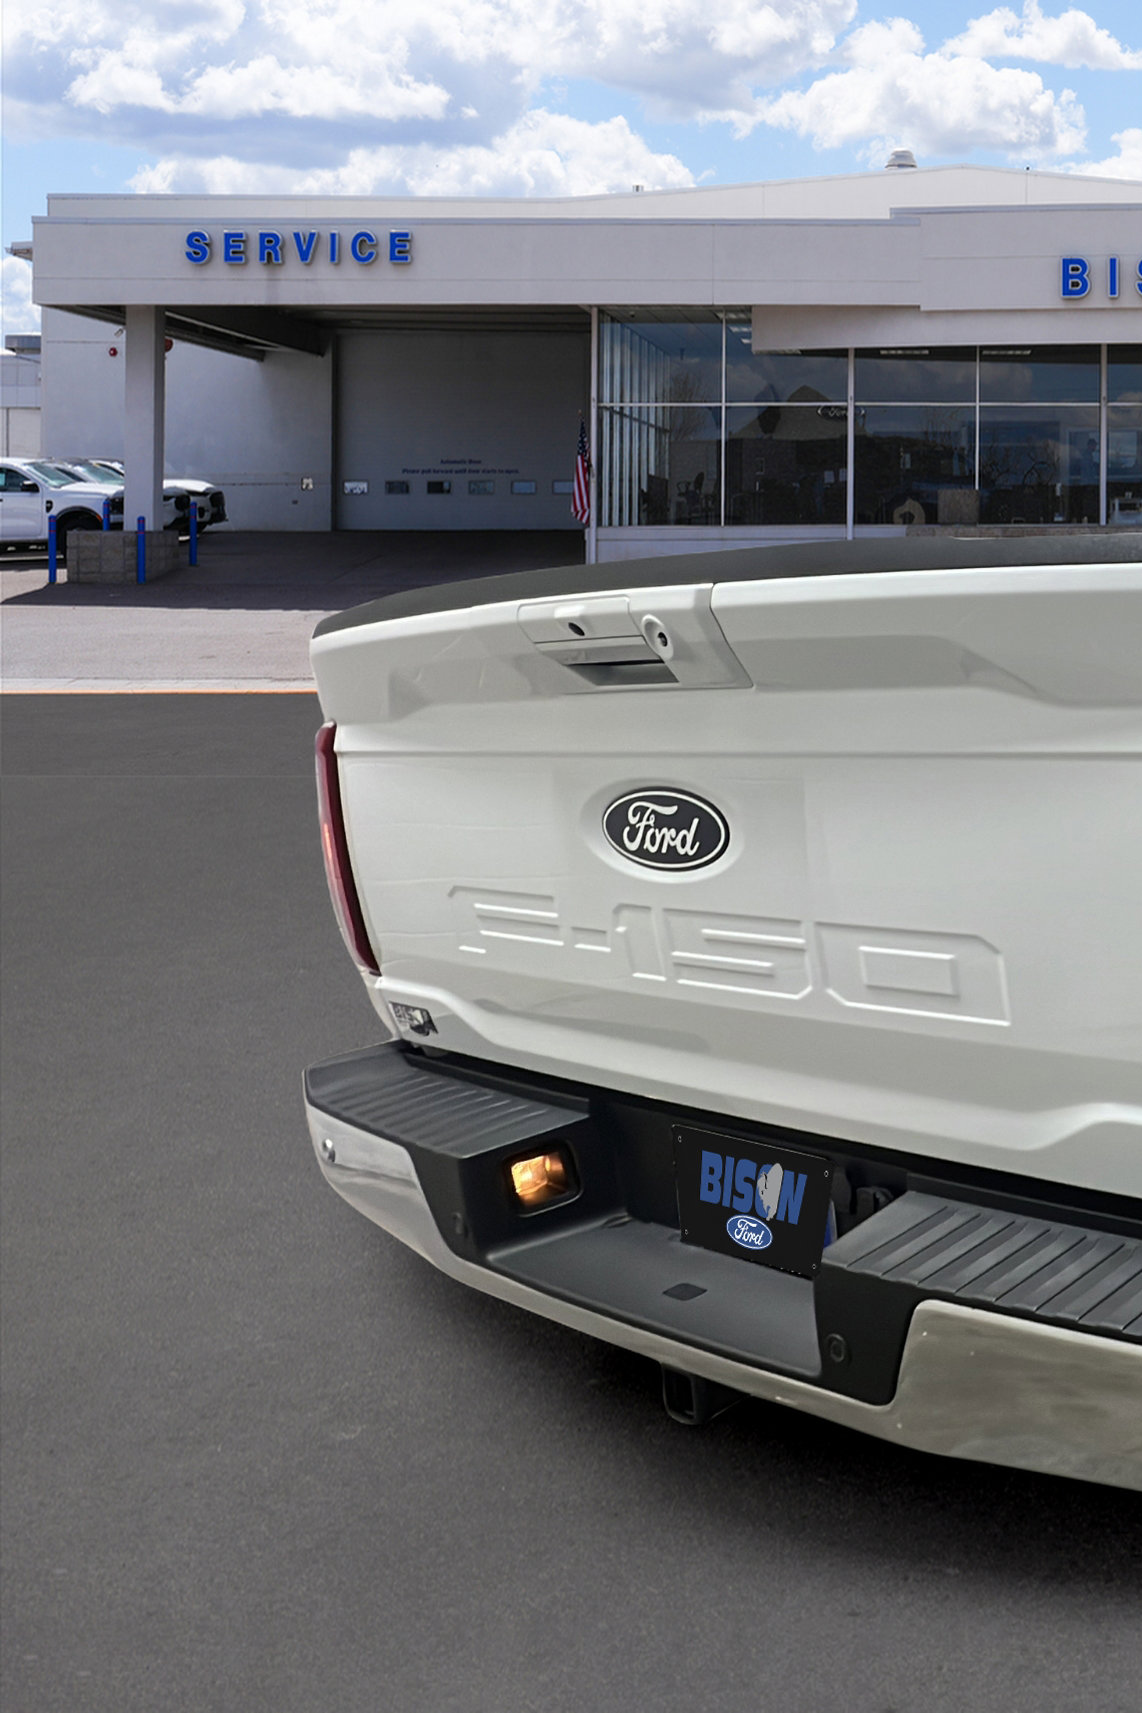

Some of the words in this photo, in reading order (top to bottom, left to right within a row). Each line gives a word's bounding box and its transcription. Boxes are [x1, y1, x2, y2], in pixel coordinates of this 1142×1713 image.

[185, 229, 412, 265] SERVICE
[623, 801, 700, 856] Ford
[448, 886, 1011, 1027] F-150
[700, 1150, 808, 1225] BISON
[734, 1218, 765, 1246] Ford
